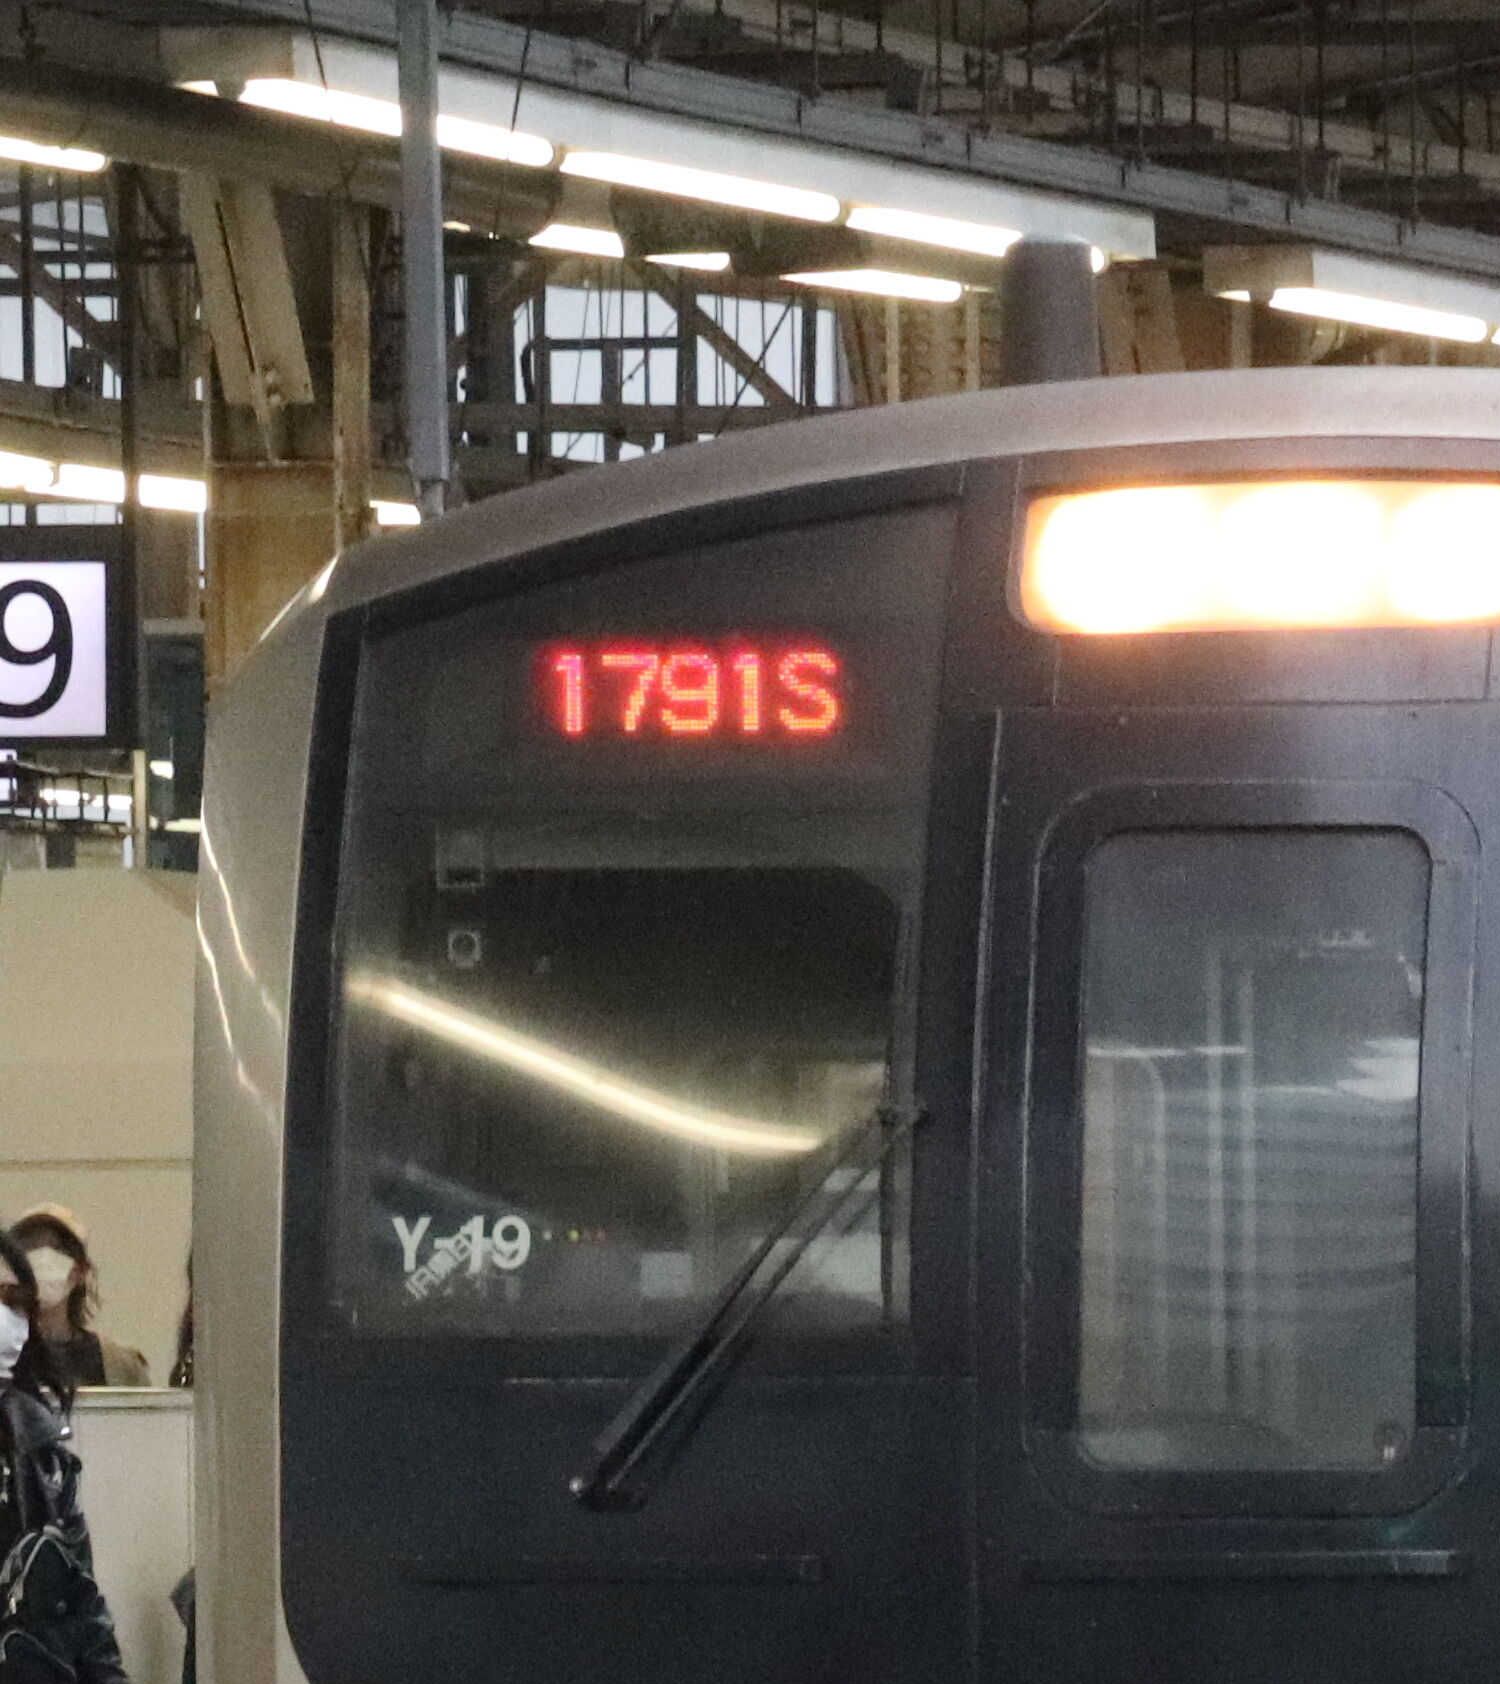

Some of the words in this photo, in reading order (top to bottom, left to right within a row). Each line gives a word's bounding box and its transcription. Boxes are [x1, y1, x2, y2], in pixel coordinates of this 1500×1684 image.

[0, 579, 73, 719] 9
[552, 650, 840, 733] 1791S
[392, 1215, 532, 1274] Y-19
